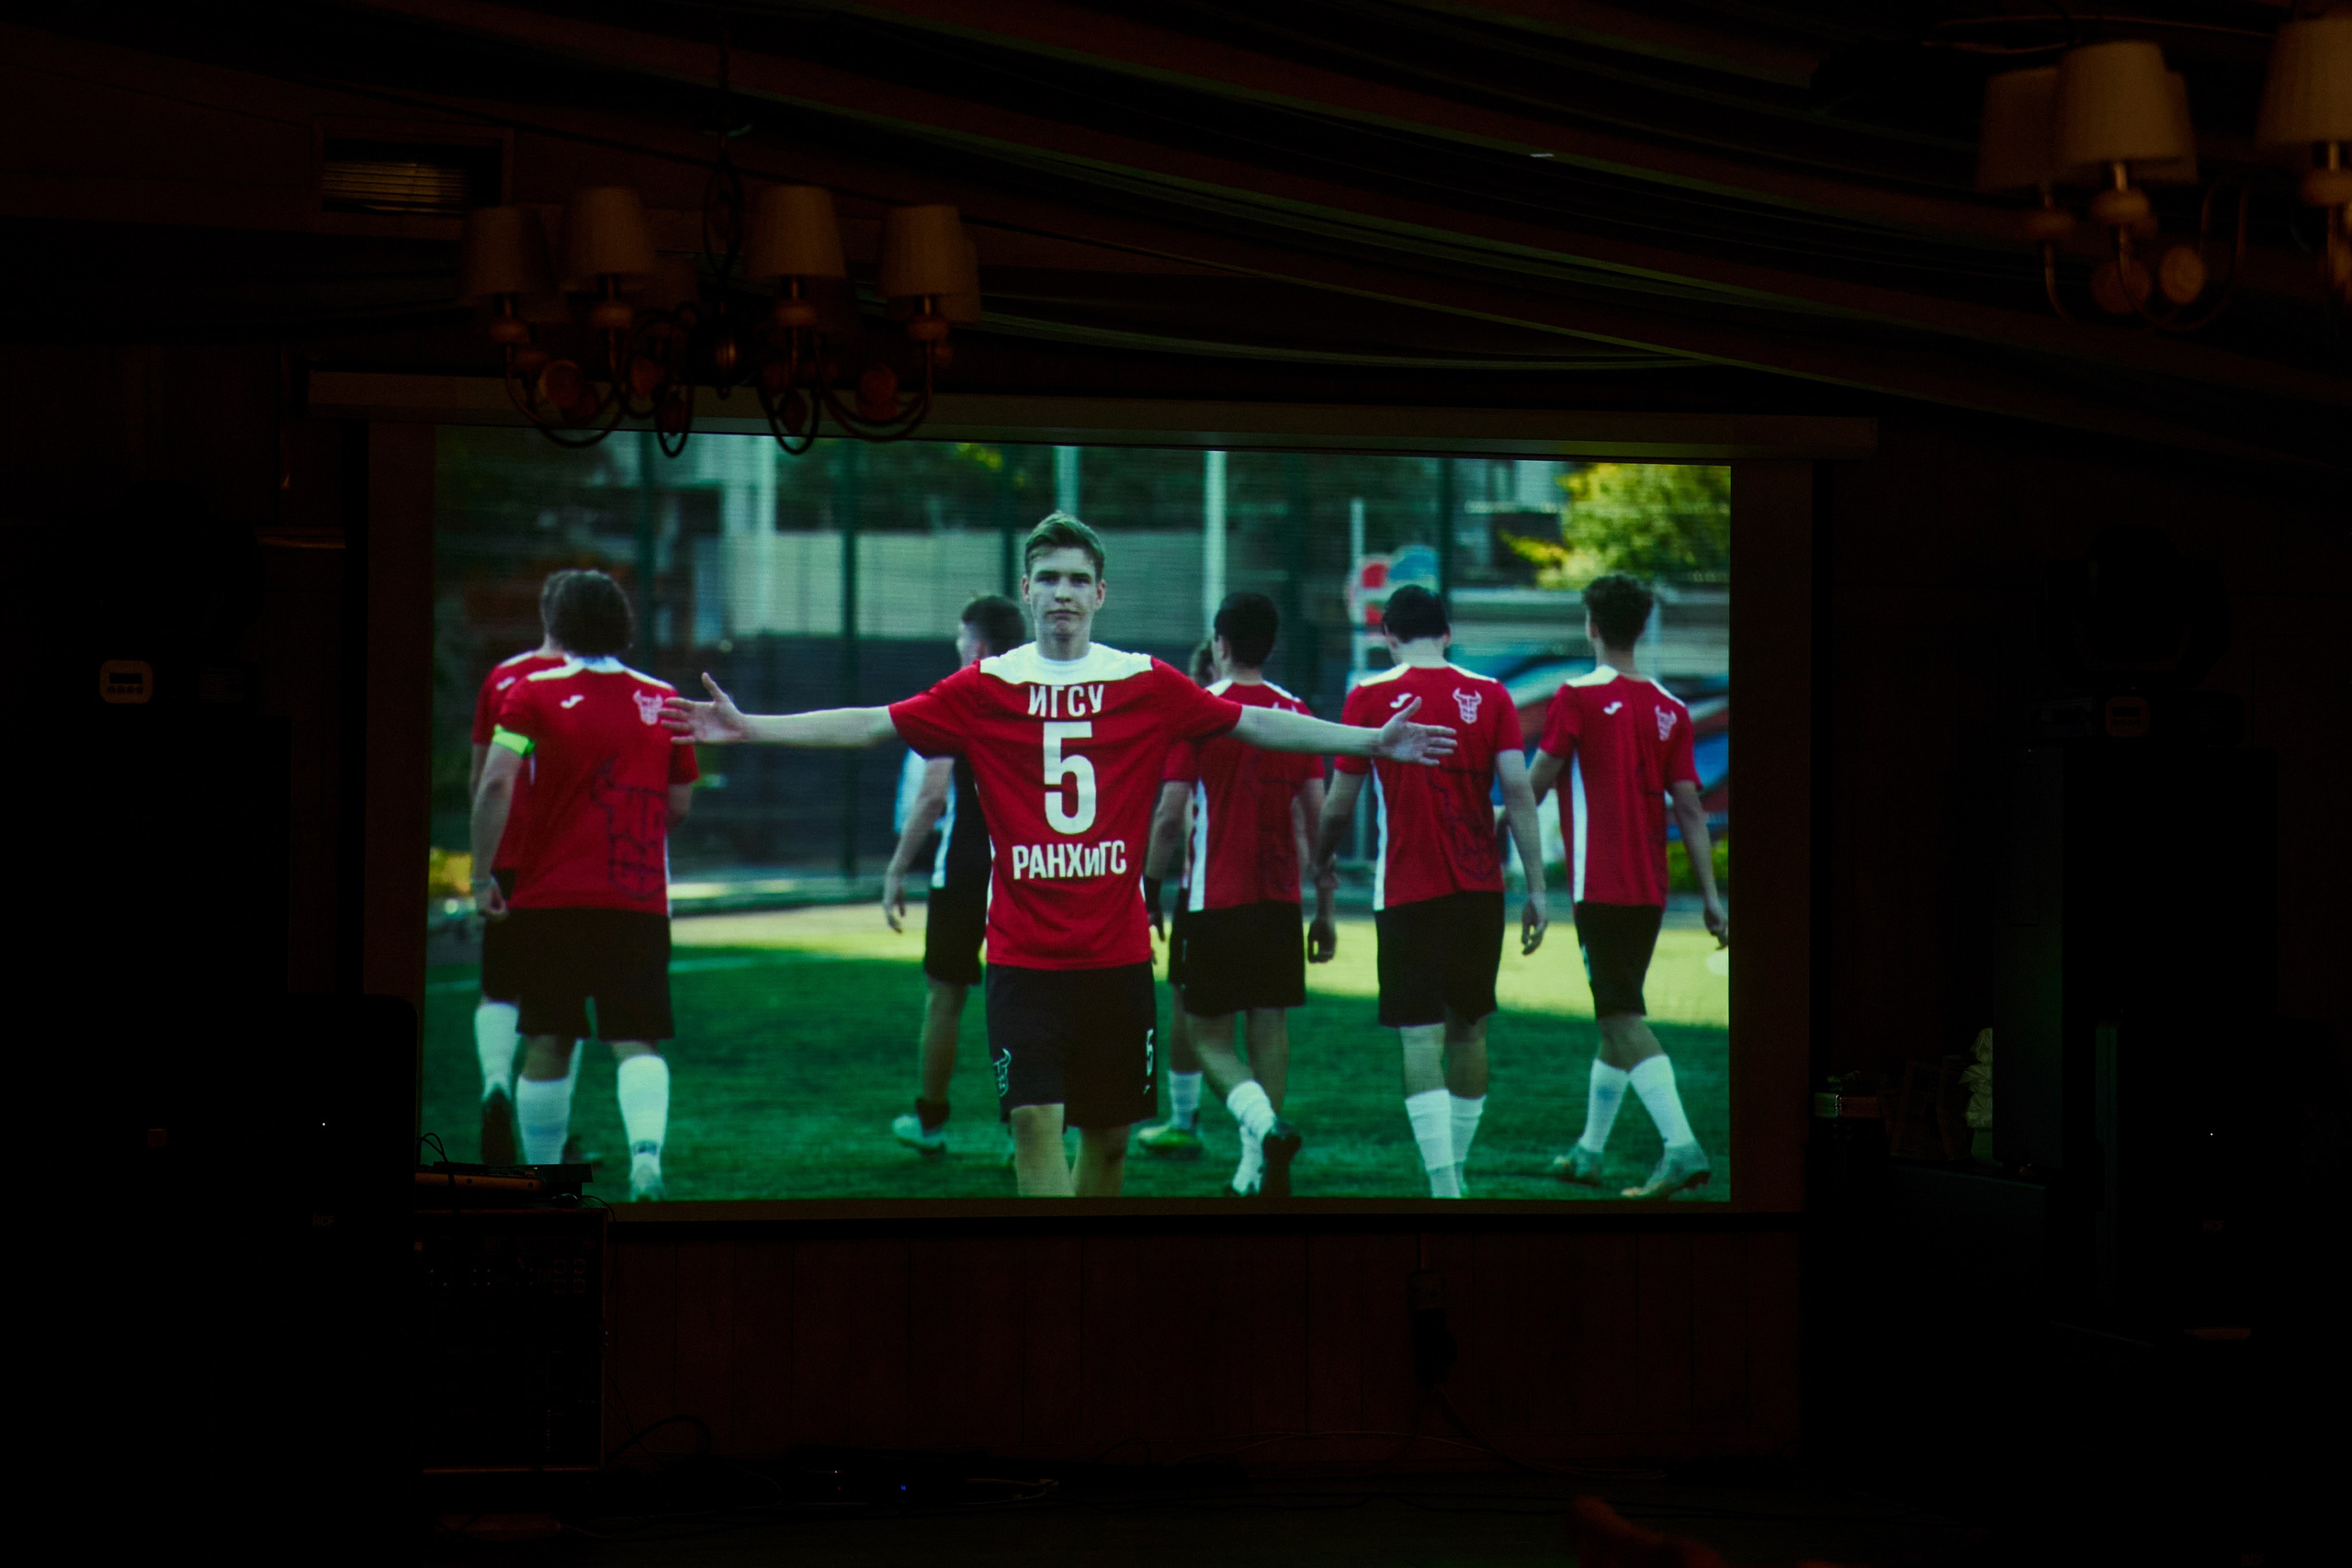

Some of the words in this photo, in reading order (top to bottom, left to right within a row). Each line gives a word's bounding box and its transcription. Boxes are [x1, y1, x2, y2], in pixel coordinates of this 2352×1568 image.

[1027, 683, 1104, 718] ИГСУ
[1043, 720, 1097, 835] 5
[1012, 840, 1127, 880] РАНХиГС
